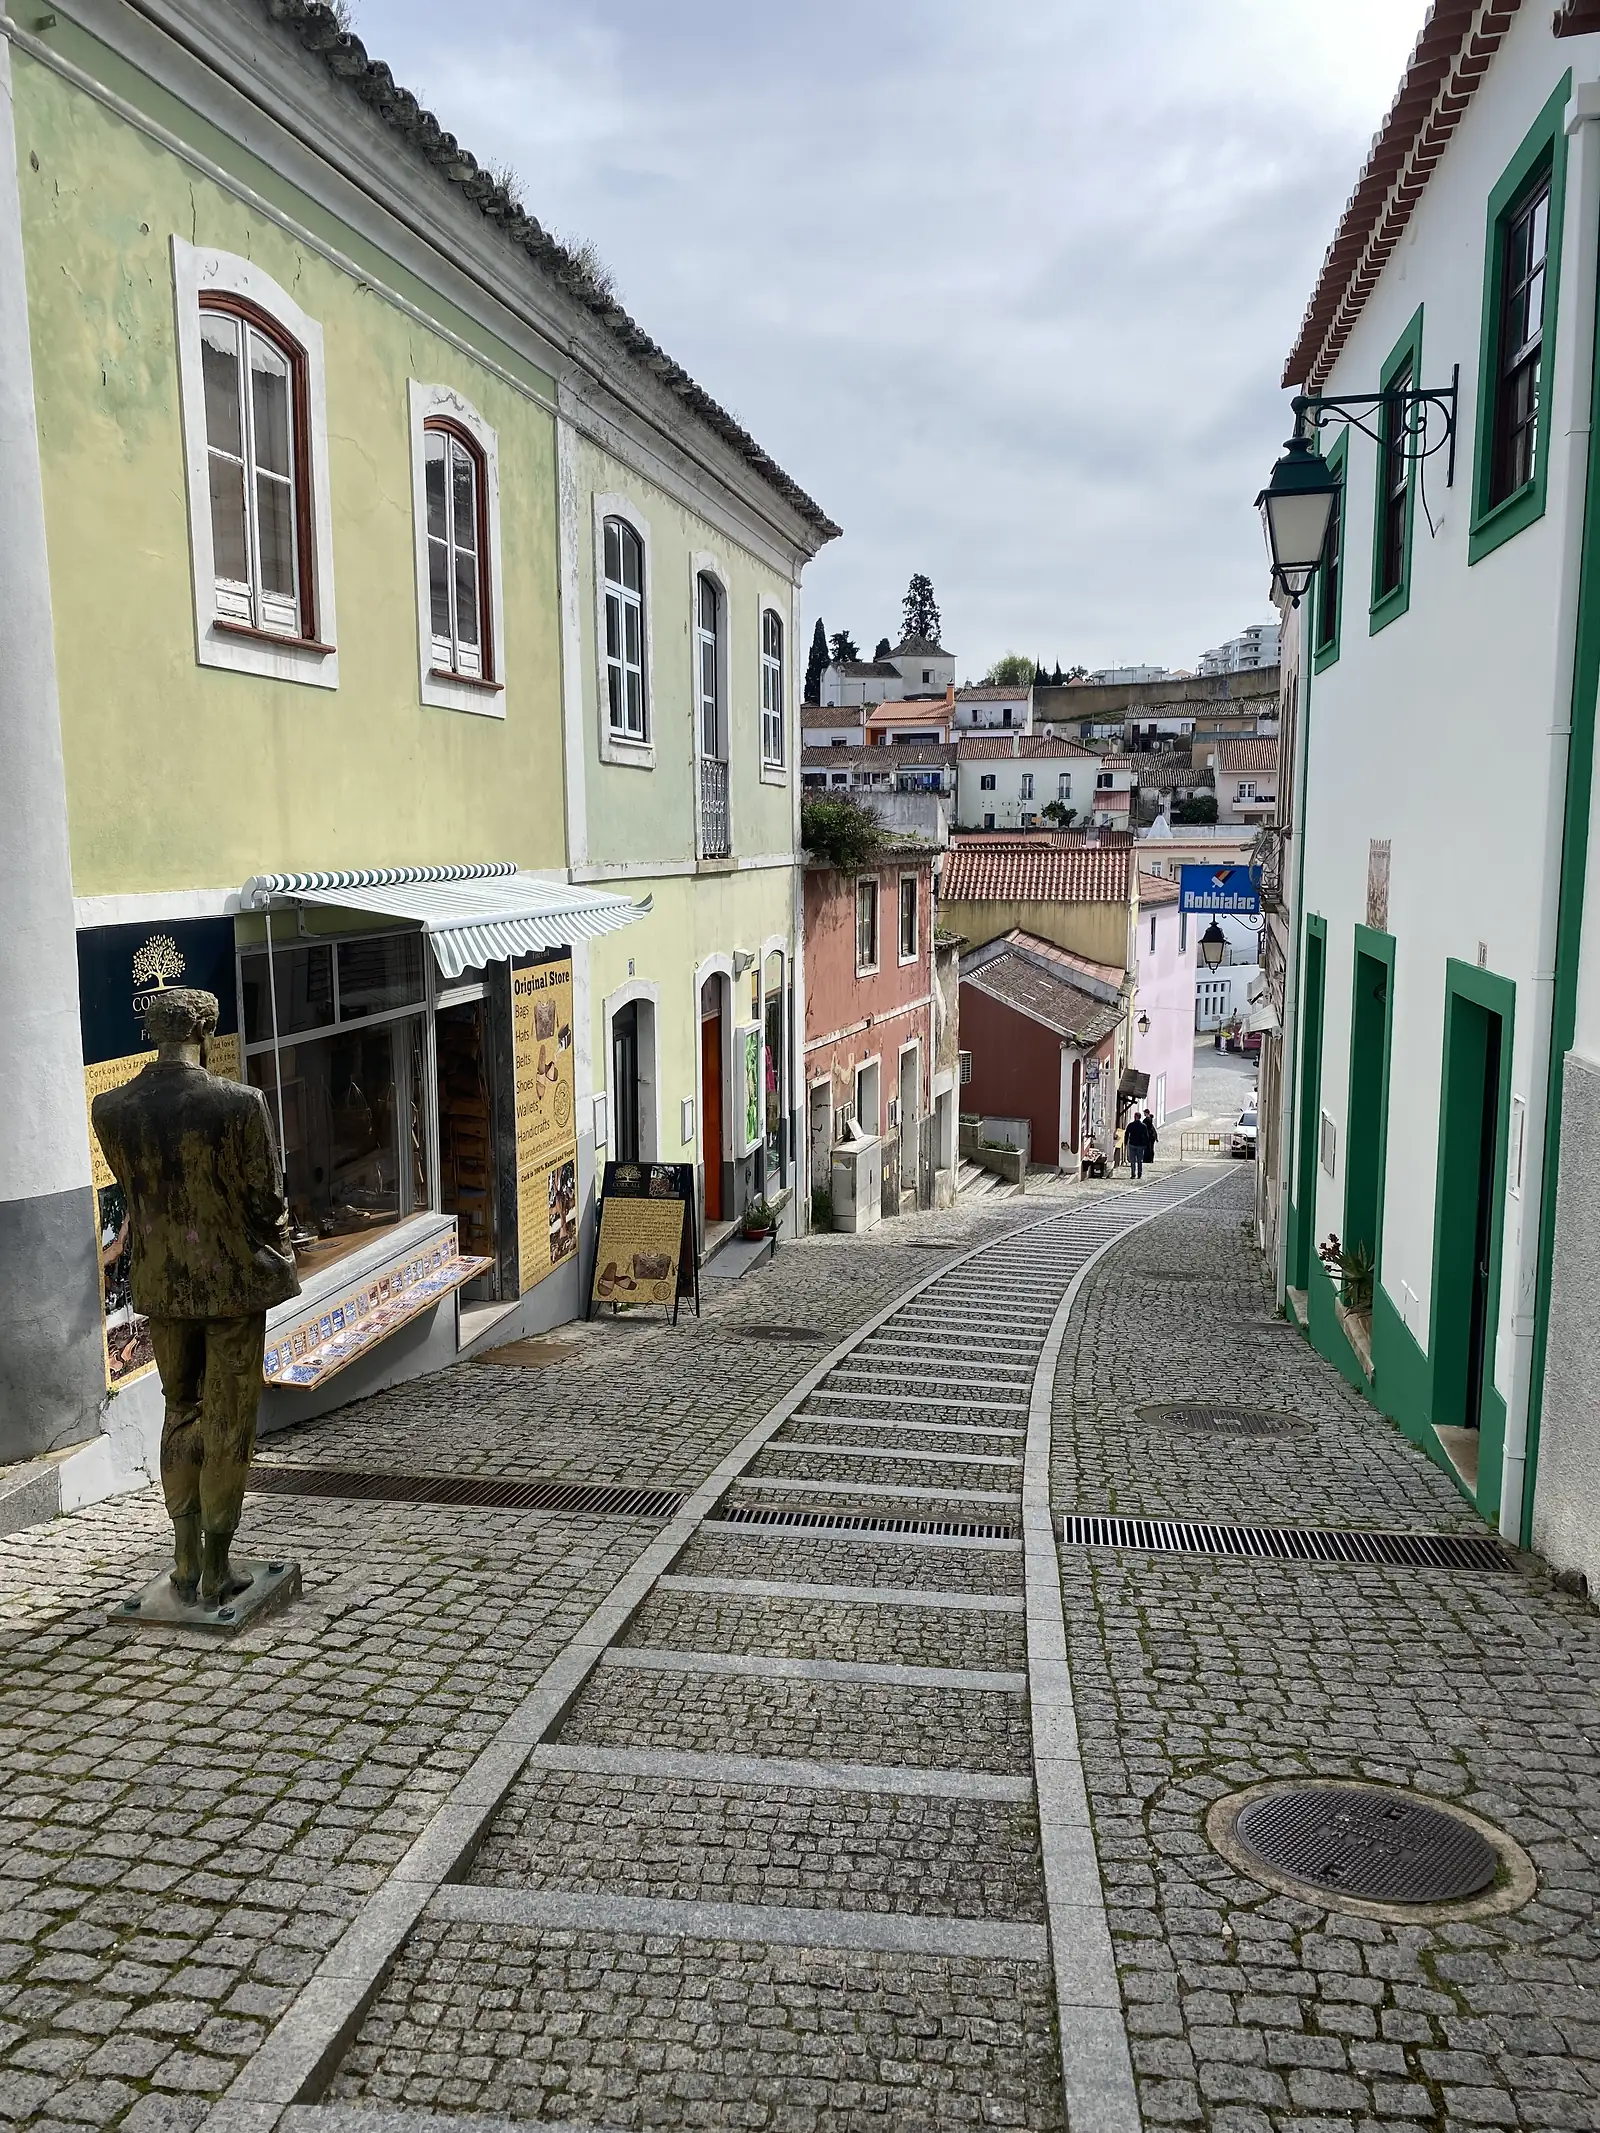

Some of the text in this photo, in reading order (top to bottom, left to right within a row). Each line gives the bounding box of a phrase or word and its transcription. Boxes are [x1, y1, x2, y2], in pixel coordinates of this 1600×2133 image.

[1184, 891, 1255, 910] Robbialac
[514, 970, 570, 996] Original Store
[515, 1004, 529, 1019] Bags
[516, 1030, 530, 1044] Hats
[516, 1054, 531, 1070] Belts
[516, 1078, 534, 1094] Shoes
[516, 1101, 539, 1119] Wallets
[517, 1119, 551, 1145] Handicrafts
